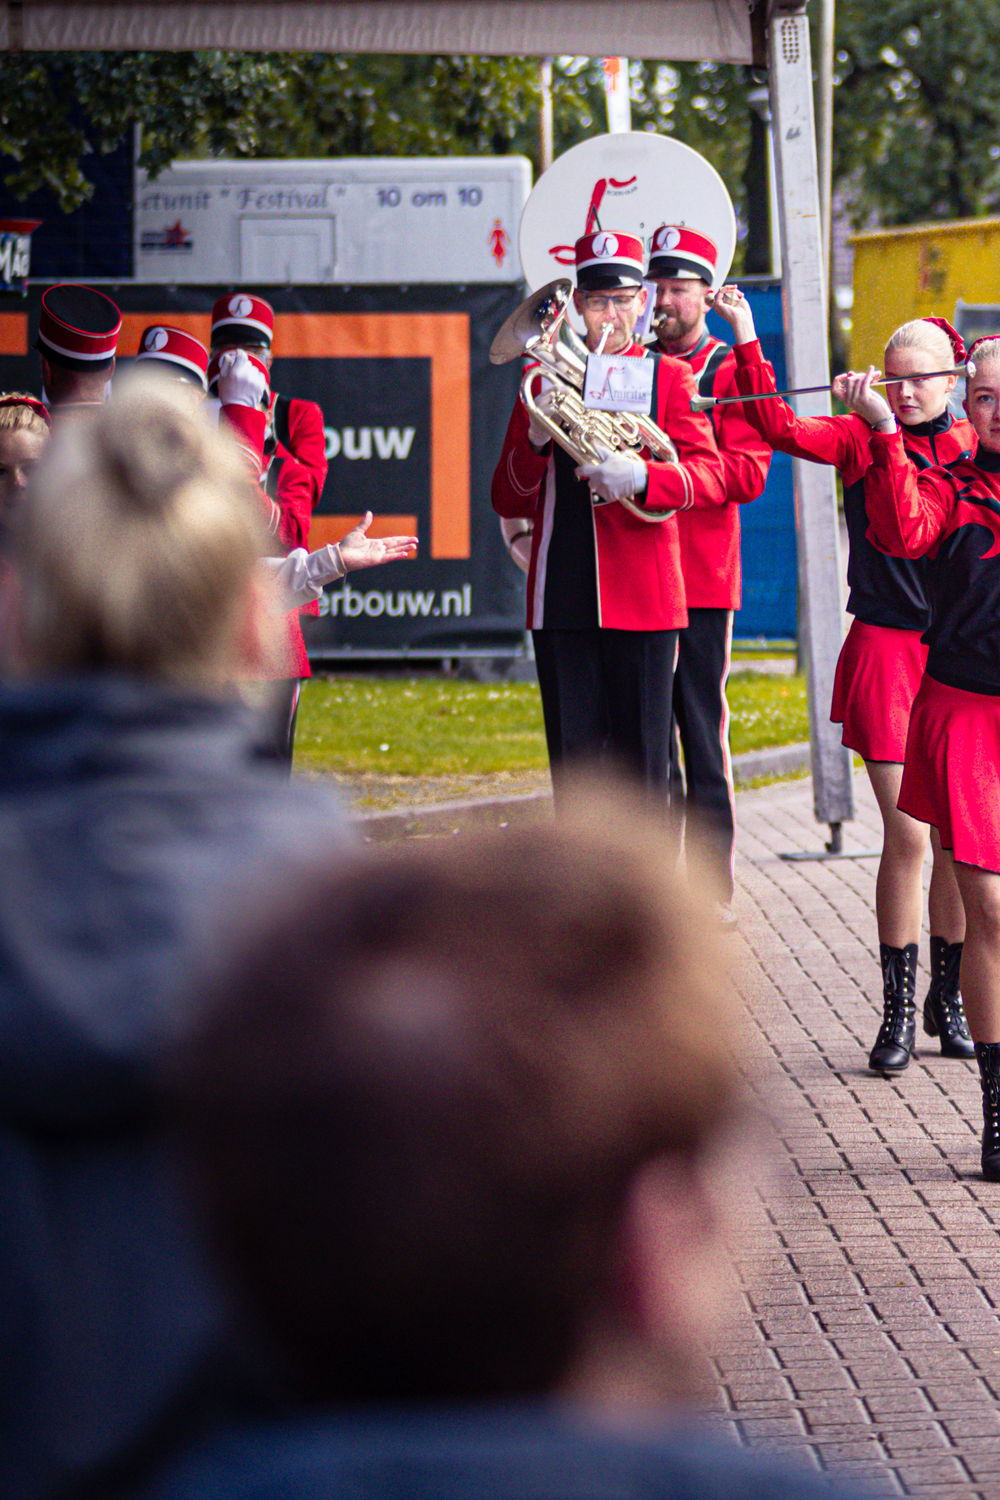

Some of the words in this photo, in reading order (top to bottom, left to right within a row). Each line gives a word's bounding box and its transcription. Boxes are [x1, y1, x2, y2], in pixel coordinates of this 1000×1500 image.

[377, 186, 402, 207] 10
[411, 191, 448, 207] om
[457, 186, 483, 207] 10
[318, 583, 472, 617] erbouw.nl
